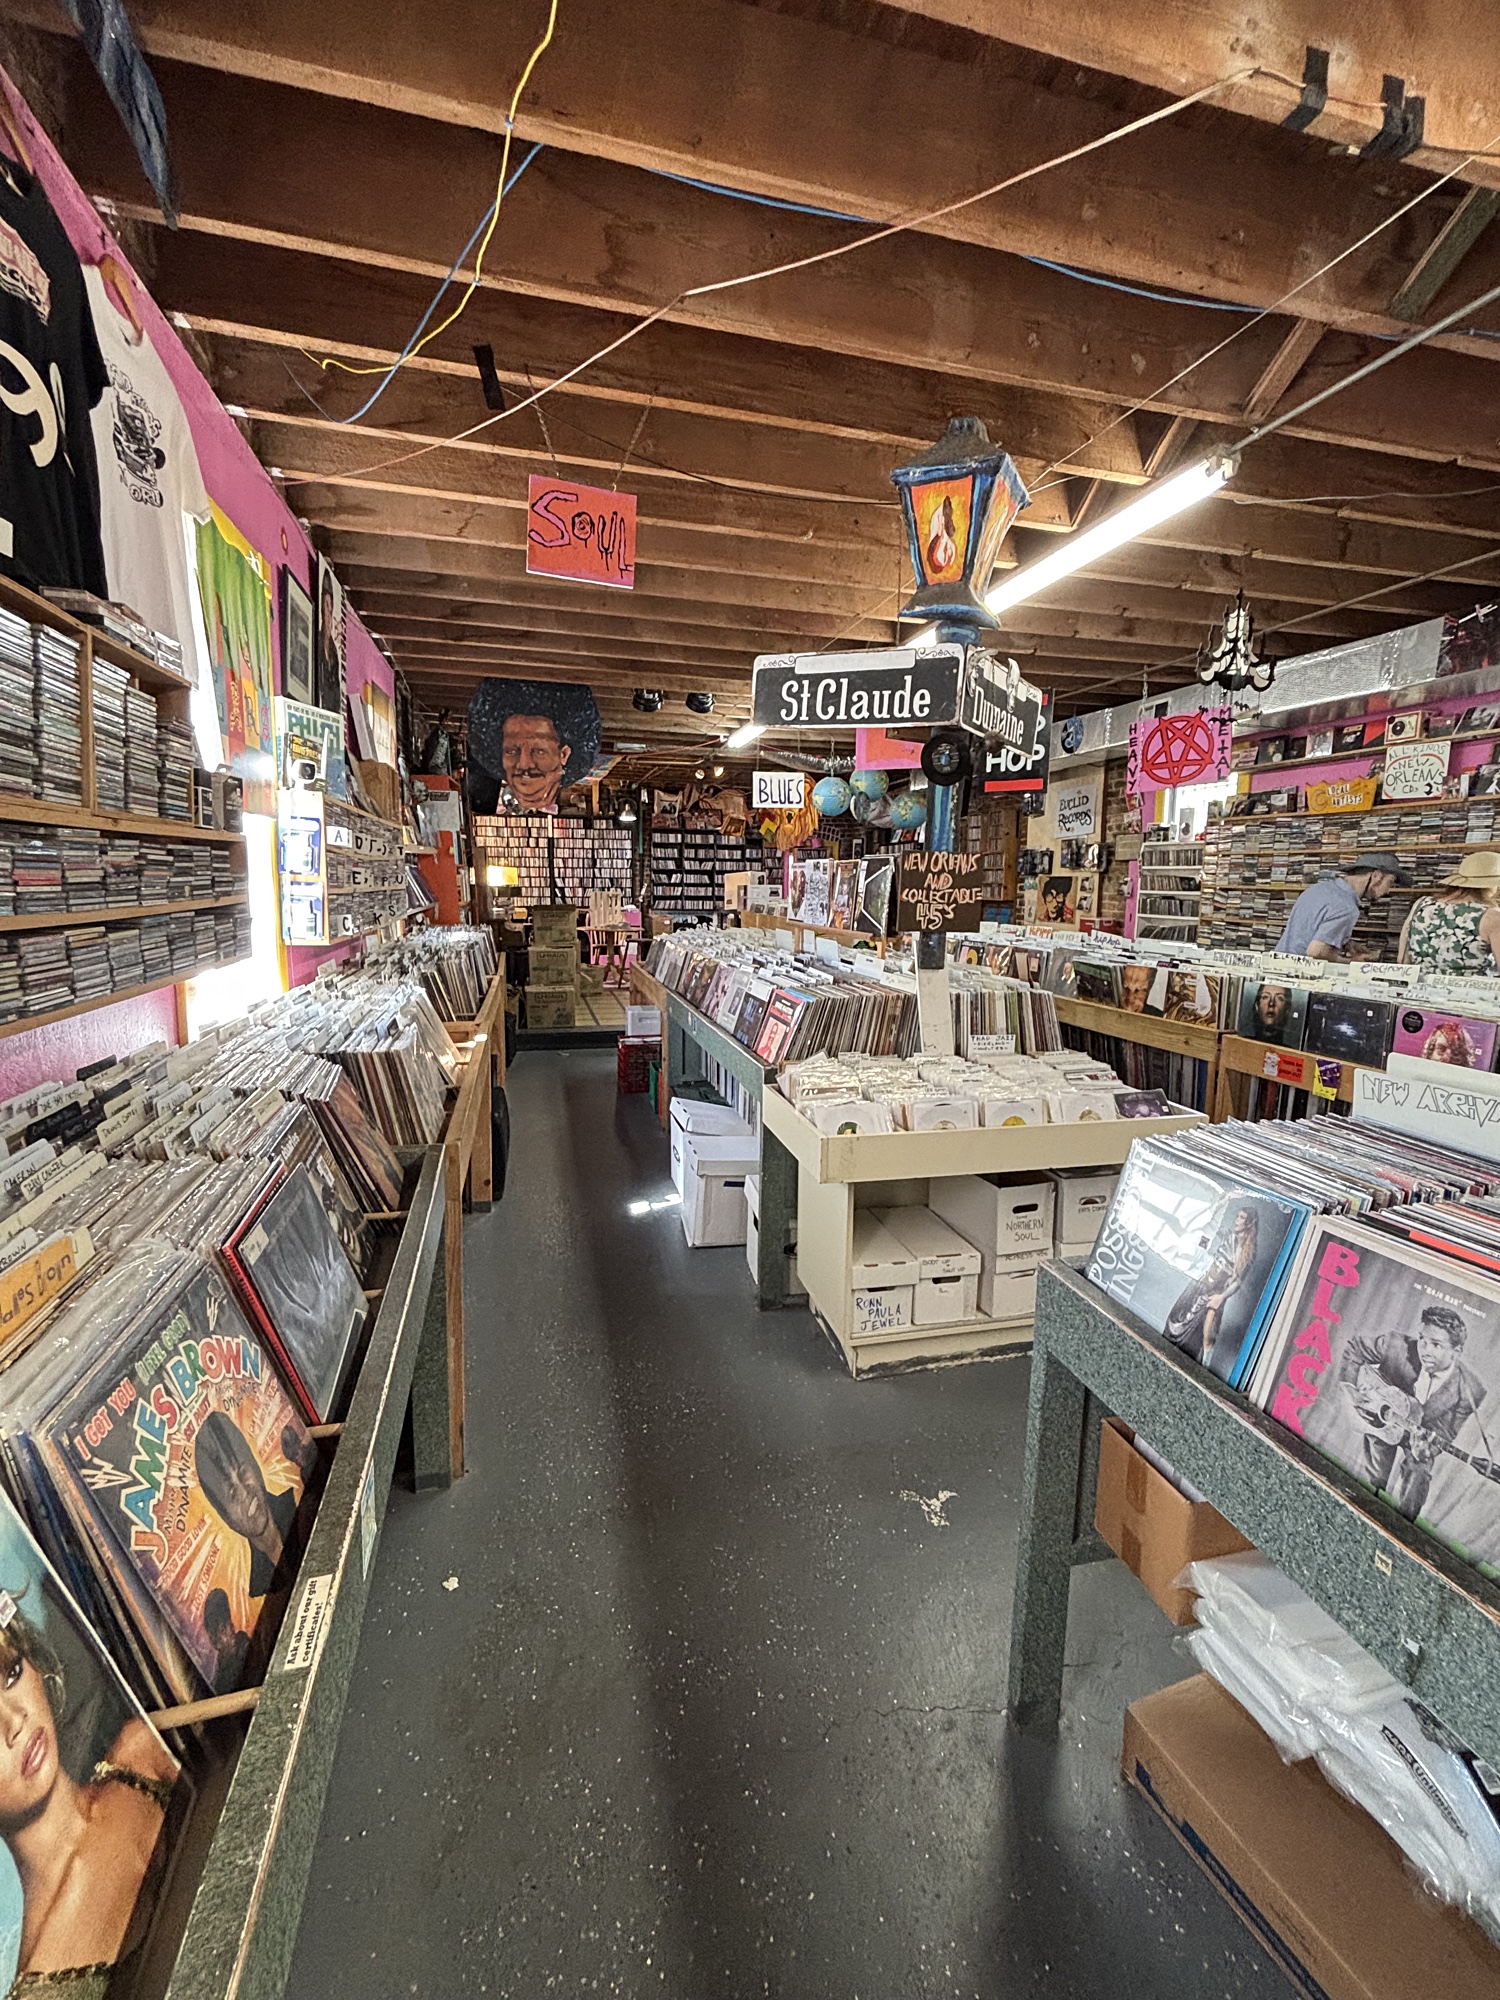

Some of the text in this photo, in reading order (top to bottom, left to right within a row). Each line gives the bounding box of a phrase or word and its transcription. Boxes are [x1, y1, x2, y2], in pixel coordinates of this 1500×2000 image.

[528, 490, 633, 578] SOUL
[780, 675, 931, 722] St Claude
[1215, 707, 1232, 780] METAL
[1413, 744, 1446, 755] KINDS
[985, 743, 1046, 773] HOP
[1128, 723, 1139, 791] HEAVY
[1398, 758, 1430, 770] NEW
[1327, 784, 1349, 796] LOCAL
[1386, 768, 1445, 787] ORLEANS
[759, 778, 804, 804] BLUES
[1059, 795, 1090, 812] EUCLID
[1332, 794, 1363, 806] ARTISTS
[903, 851, 981, 878] NEW ORLEANS
[924, 872, 953, 890] AND
[1360, 963, 1412, 976] electronic
[1362, 1074, 1410, 1107] NEW
[1006, 1219, 1044, 1231] NORTHERN
[1015, 1232, 1040, 1242] SOUL
[856, 1297, 883, 1310] RONN
[868, 1304, 902, 1319] PAULA
[861, 1317, 906, 1331] JEWEL
[1271, 1241, 1360, 1437] BLACK
[84, 1405, 115, 1447] GOT
[108, 1377, 136, 1416] YOU
[121, 1384, 181, 1568] JAMES
[167, 1335, 263, 1406] BROWN
[176, 1446, 193, 1533] DYNAMITE
[199, 1544, 221, 1587] SOMEONE
[287, 1579, 318, 1665] Ask about our gift
